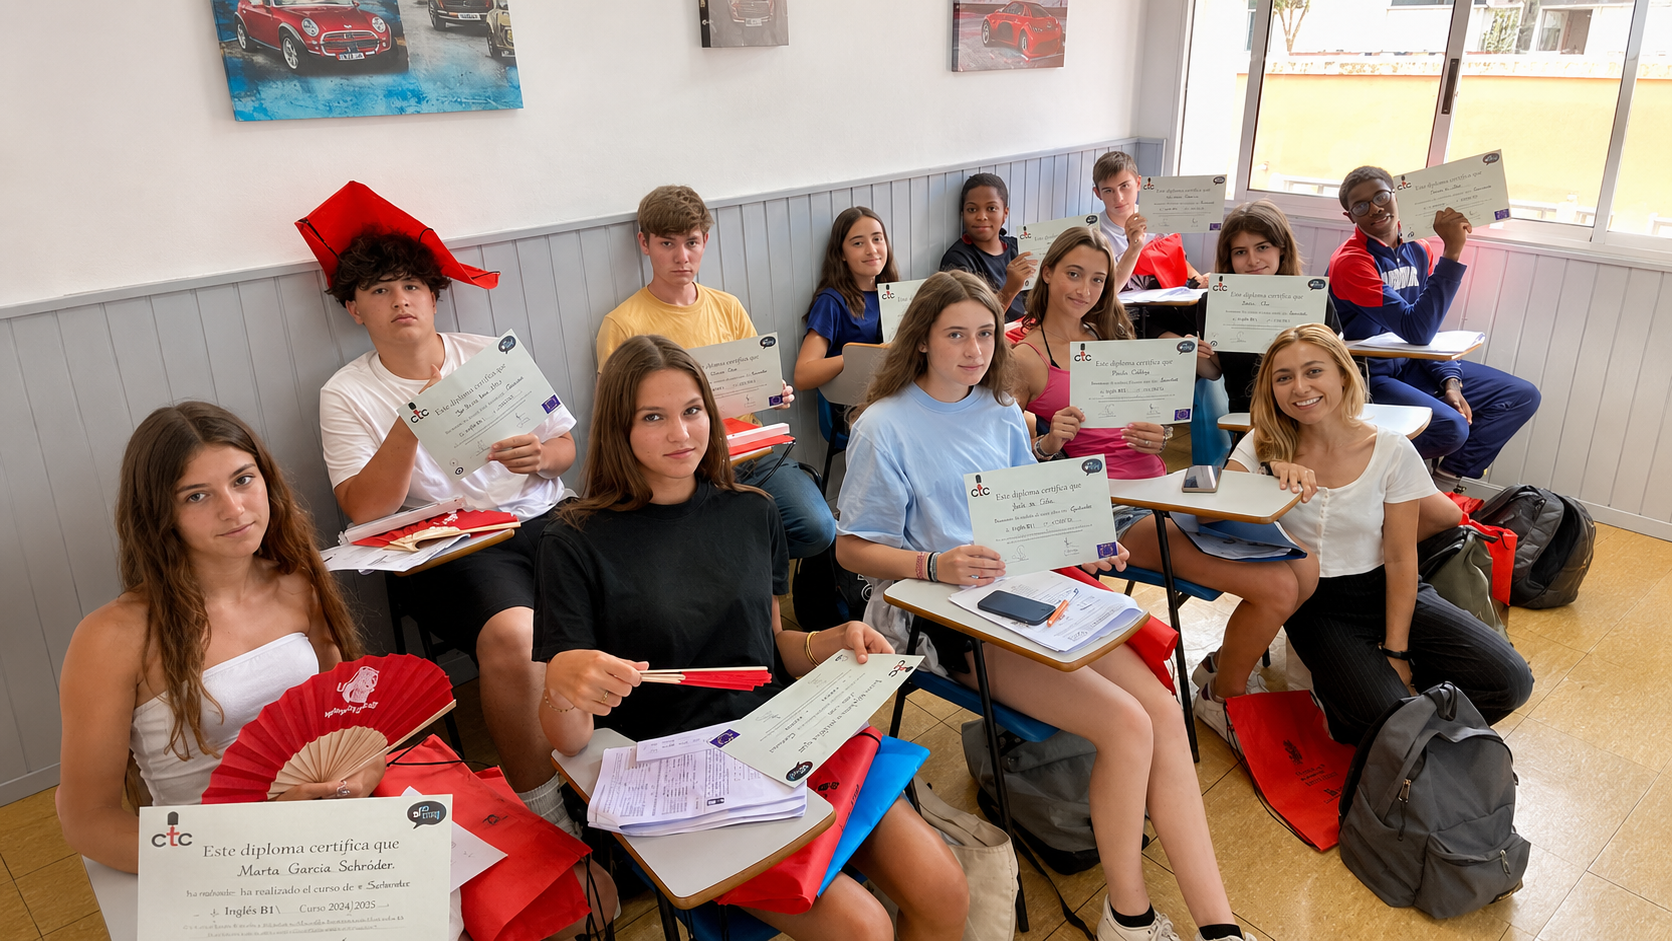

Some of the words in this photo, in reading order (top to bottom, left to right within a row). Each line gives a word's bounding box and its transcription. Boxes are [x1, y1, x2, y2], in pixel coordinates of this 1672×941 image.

[410, 408, 430, 424] ctc
[970, 483, 991, 497] ctc
[1011, 488, 1040, 500] diploma
[1041, 484, 1068, 497] certifica
[1070, 482, 1082, 491] que
[151, 825, 193, 848] ctc
[203, 844, 236, 858] Este
[240, 842, 305, 860] diploma
[309, 838, 370, 856] certifica
[374, 839, 400, 854] que
[236, 864, 280, 877] Marta
[240, 887, 252, 896] ha
[255, 884, 301, 896] realizado
[302, 883, 312, 894] el
[313, 884, 341, 894] curso
[342, 882, 355, 892] de
[224, 905, 257, 918] Inglés
[299, 903, 326, 914] Curso
